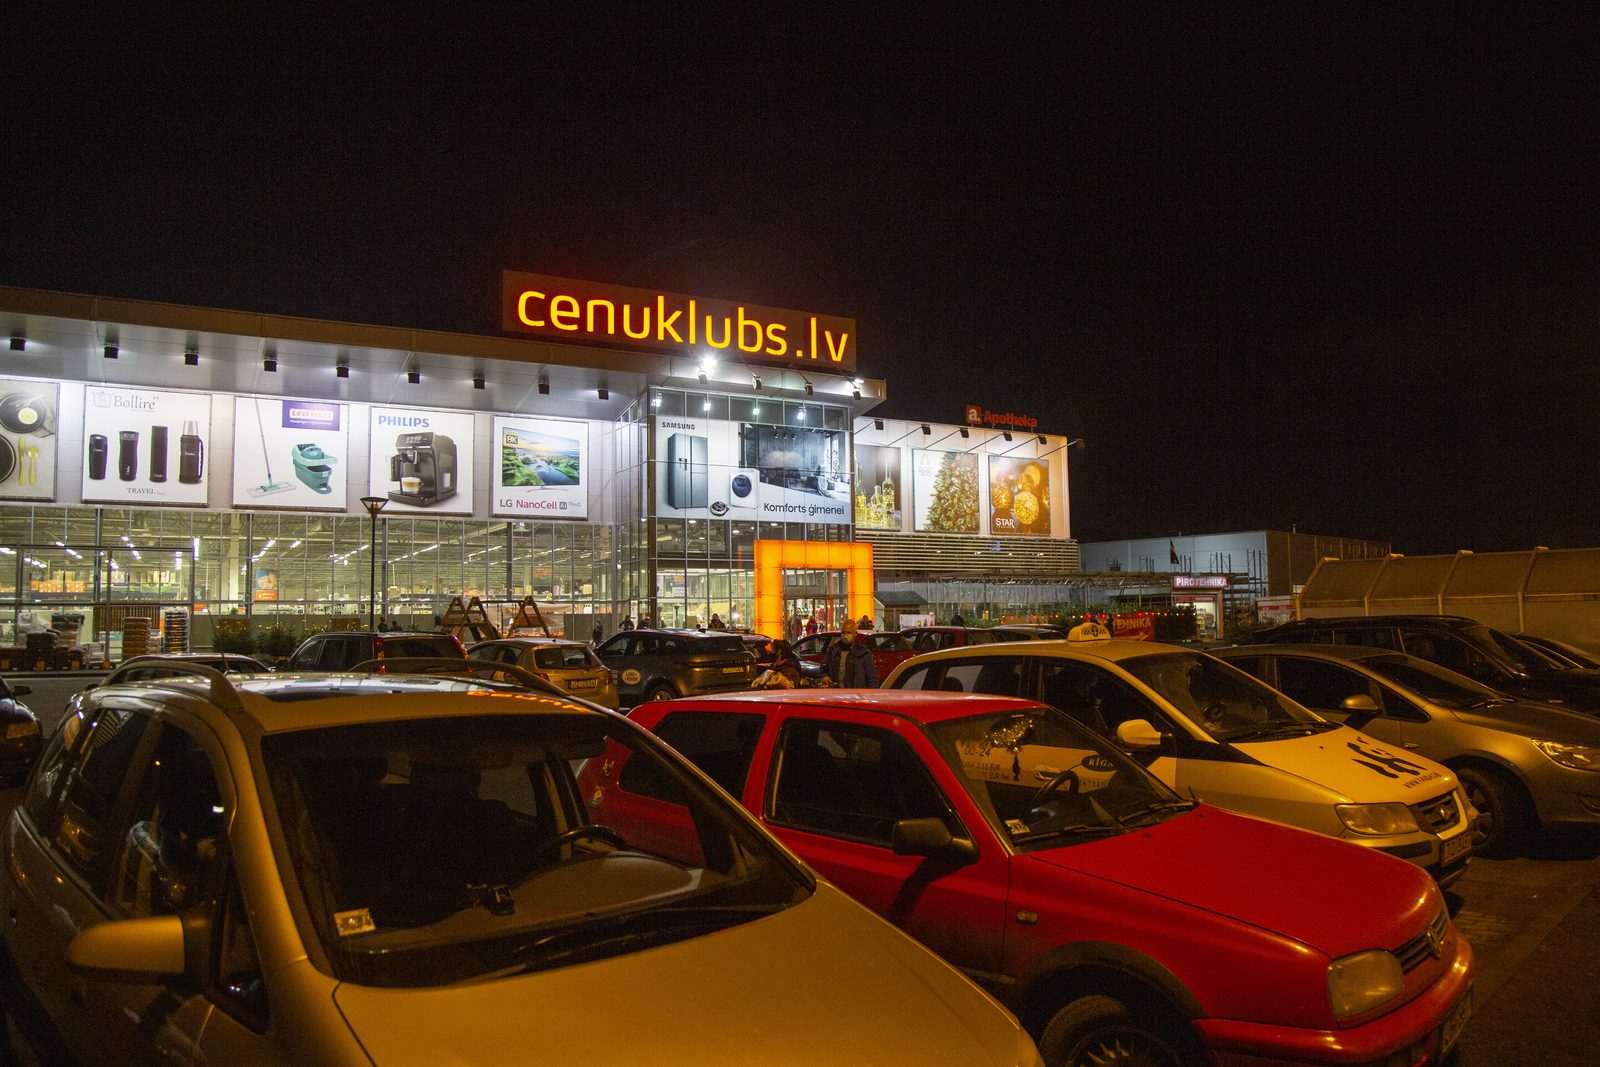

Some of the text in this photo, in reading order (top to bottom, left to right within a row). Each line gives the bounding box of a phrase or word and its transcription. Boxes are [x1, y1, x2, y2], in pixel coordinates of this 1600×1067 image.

[517, 289, 849, 363] cenuklubs.lv
[114, 395, 156, 410] Bollire
[378, 415, 430, 428] PHILIPS
[984, 410, 1038, 427] Apotheka
[662, 421, 696, 430] SAMSUNG
[500, 499, 513, 508] LG
[516, 499, 558, 510] NanoCell
[763, 503, 806, 514] Komforts
[995, 518, 1015, 528] STAR
[1176, 578, 1227, 587] PIROTEHNIKA
